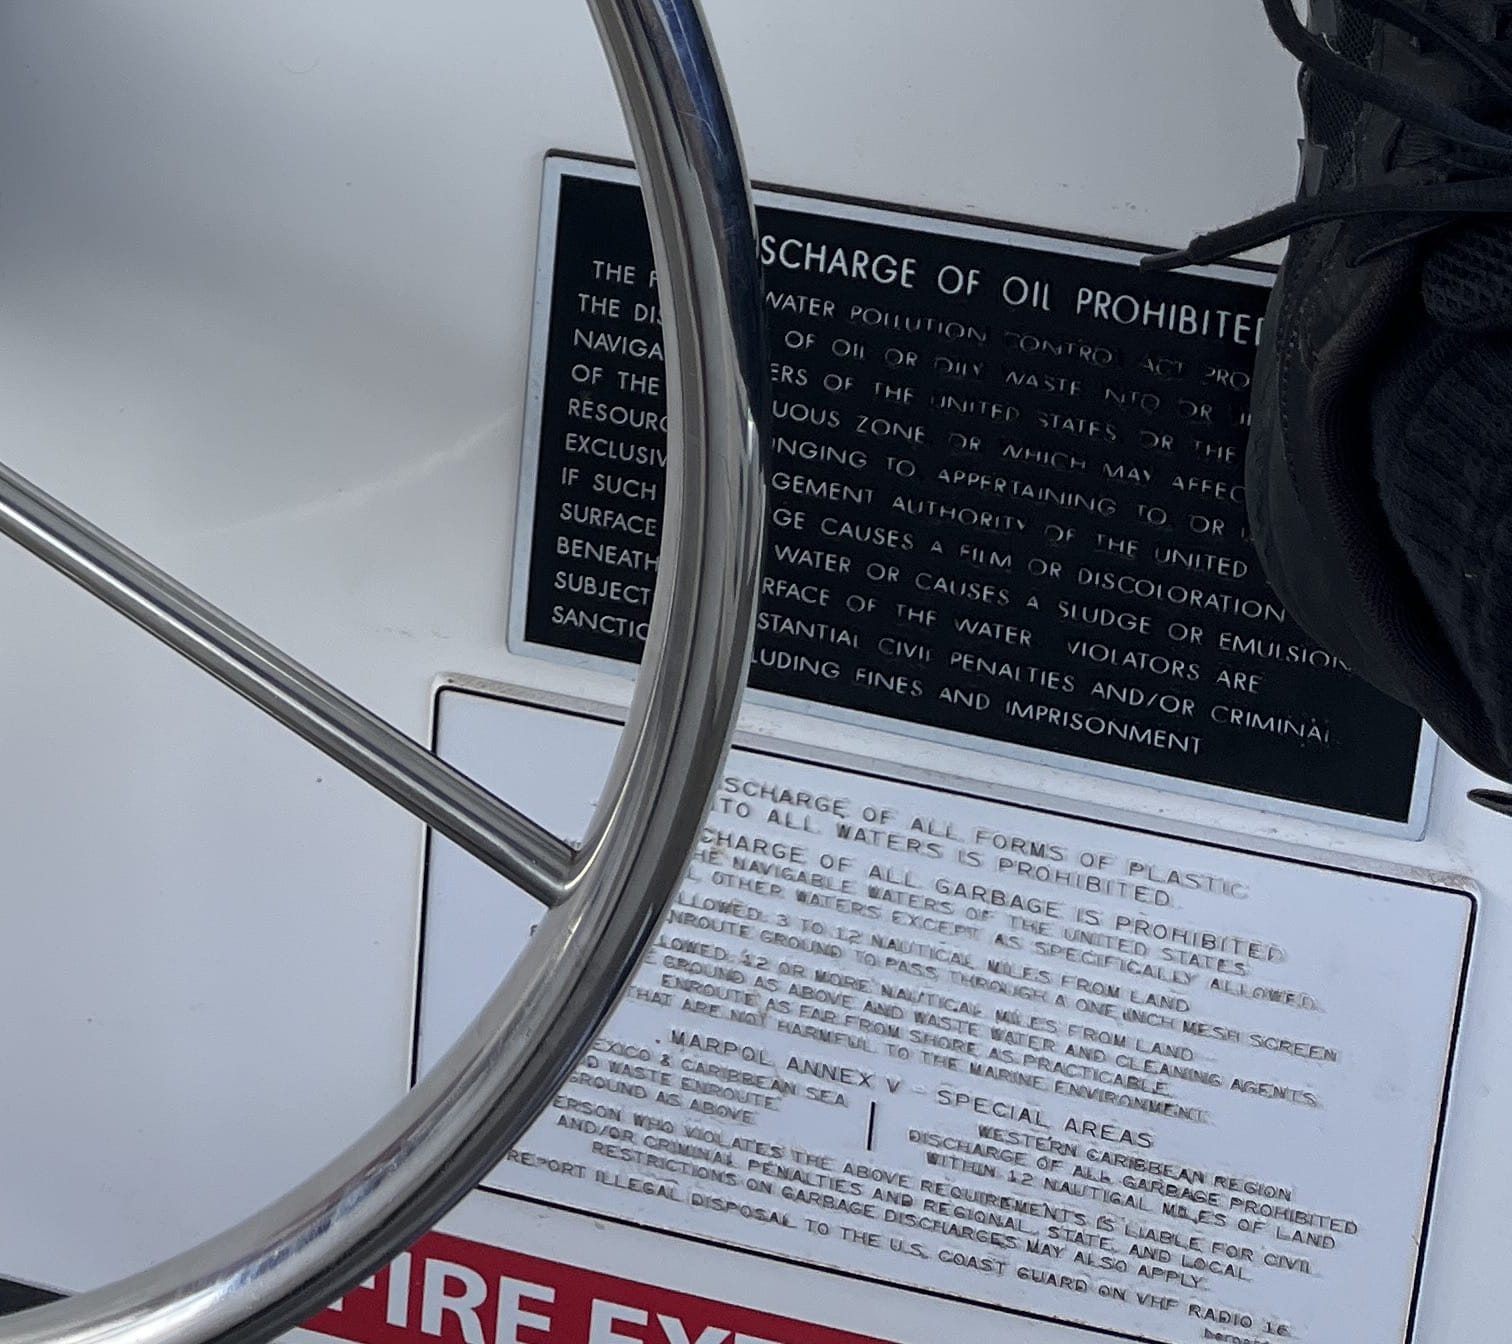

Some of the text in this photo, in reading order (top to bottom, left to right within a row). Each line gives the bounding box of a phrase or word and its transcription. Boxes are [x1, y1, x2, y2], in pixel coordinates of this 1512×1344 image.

[591, 259, 636, 286] THE
[758, 234, 917, 290] SCHARGE
[936, 263, 981, 300] OF
[1000, 274, 1053, 312] OIL
[576, 292, 620, 319] THE
[783, 328, 817, 353] OF
[884, 346, 918, 369] OR
[570, 362, 603, 386] OF
[616, 370, 660, 396] THE
[854, 414, 925, 445] ZONE
[823, 372, 854, 394] OF
[885, 457, 916, 478] TO
[1135, 503, 1168, 526] TO
[1189, 513, 1226, 537] OR
[559, 501, 1205, 646] SURFACE WATER OR CAUSES A SLUDGE OR
[560, 466, 580, 488] IF
[591, 472, 657, 502] SUCH
[819, 515, 915, 552] CAUSES
[930, 537, 945, 555] A
[1027, 557, 1062, 579] OR
[1077, 567, 1286, 625] DISCOLORATION
[1043, 523, 1249, 580] OF THE UNITED
[553, 570, 1196, 717] SUBJECT PENALTIES AND/OR
[556, 535, 1262, 695] BENEATH OF THE WATER VIOLATORS ARE
[854, 666, 1203, 756] FINES AND IMPRISONMENT
[766, 808, 819, 834] ALL
[835, 822, 944, 858] WATERS
[956, 847, 982, 867] IS
[861, 805, 1250, 900] OF ALL FORMS OF PLASTIC
[711, 870, 784, 899] OTHER
[732, 856, 852, 895] NAVIGABLE
[965, 905, 993, 925] OF
[1008, 915, 1049, 936] THE
[1062, 926, 1149, 957] UNITED
[1160, 946, 1249, 978] STATES
[819, 852, 1287, 965] OF ALL GARBAGE IS PROHIBITED
[787, 981, 905, 1020] ABOVE AND
[1060, 974, 1192, 1014] FROM LAND
[607, 1059, 671, 1088] WASTE
[1135, 1037, 1194, 1063] LAND
[1247, 1032, 1338, 1064] SCREEN
[670, 1028, 1155, 1150] MARPOL ANNEX V SPECIAL AREAS
[689, 1097, 755, 1124] ABOVE
[804, 1085, 847, 1108] SEA
[632, 1113, 1255, 1263] WHO VIOLATES THE ABOVE REQUIREMENTS IS LIABLE FOR
[908, 1127, 1359, 1238] DISCHARGE GARBAGE PROHIBITED
[977, 1123, 1292, 1203] WESTERN CARIBBEAN REGION
[591, 1139, 1128, 1275] RESTRICTIONS ON GARBAGE DISCHARGES MAY ALSO
[747, 1157, 1250, 1282] PENALTIES AND AND LOCAL
[1236, 1217, 1336, 1251] OF LAND
[595, 1169, 1254, 1331] ILLEGAL DISPOSAL TO THE COAST GUARD ON VHF RADIO
